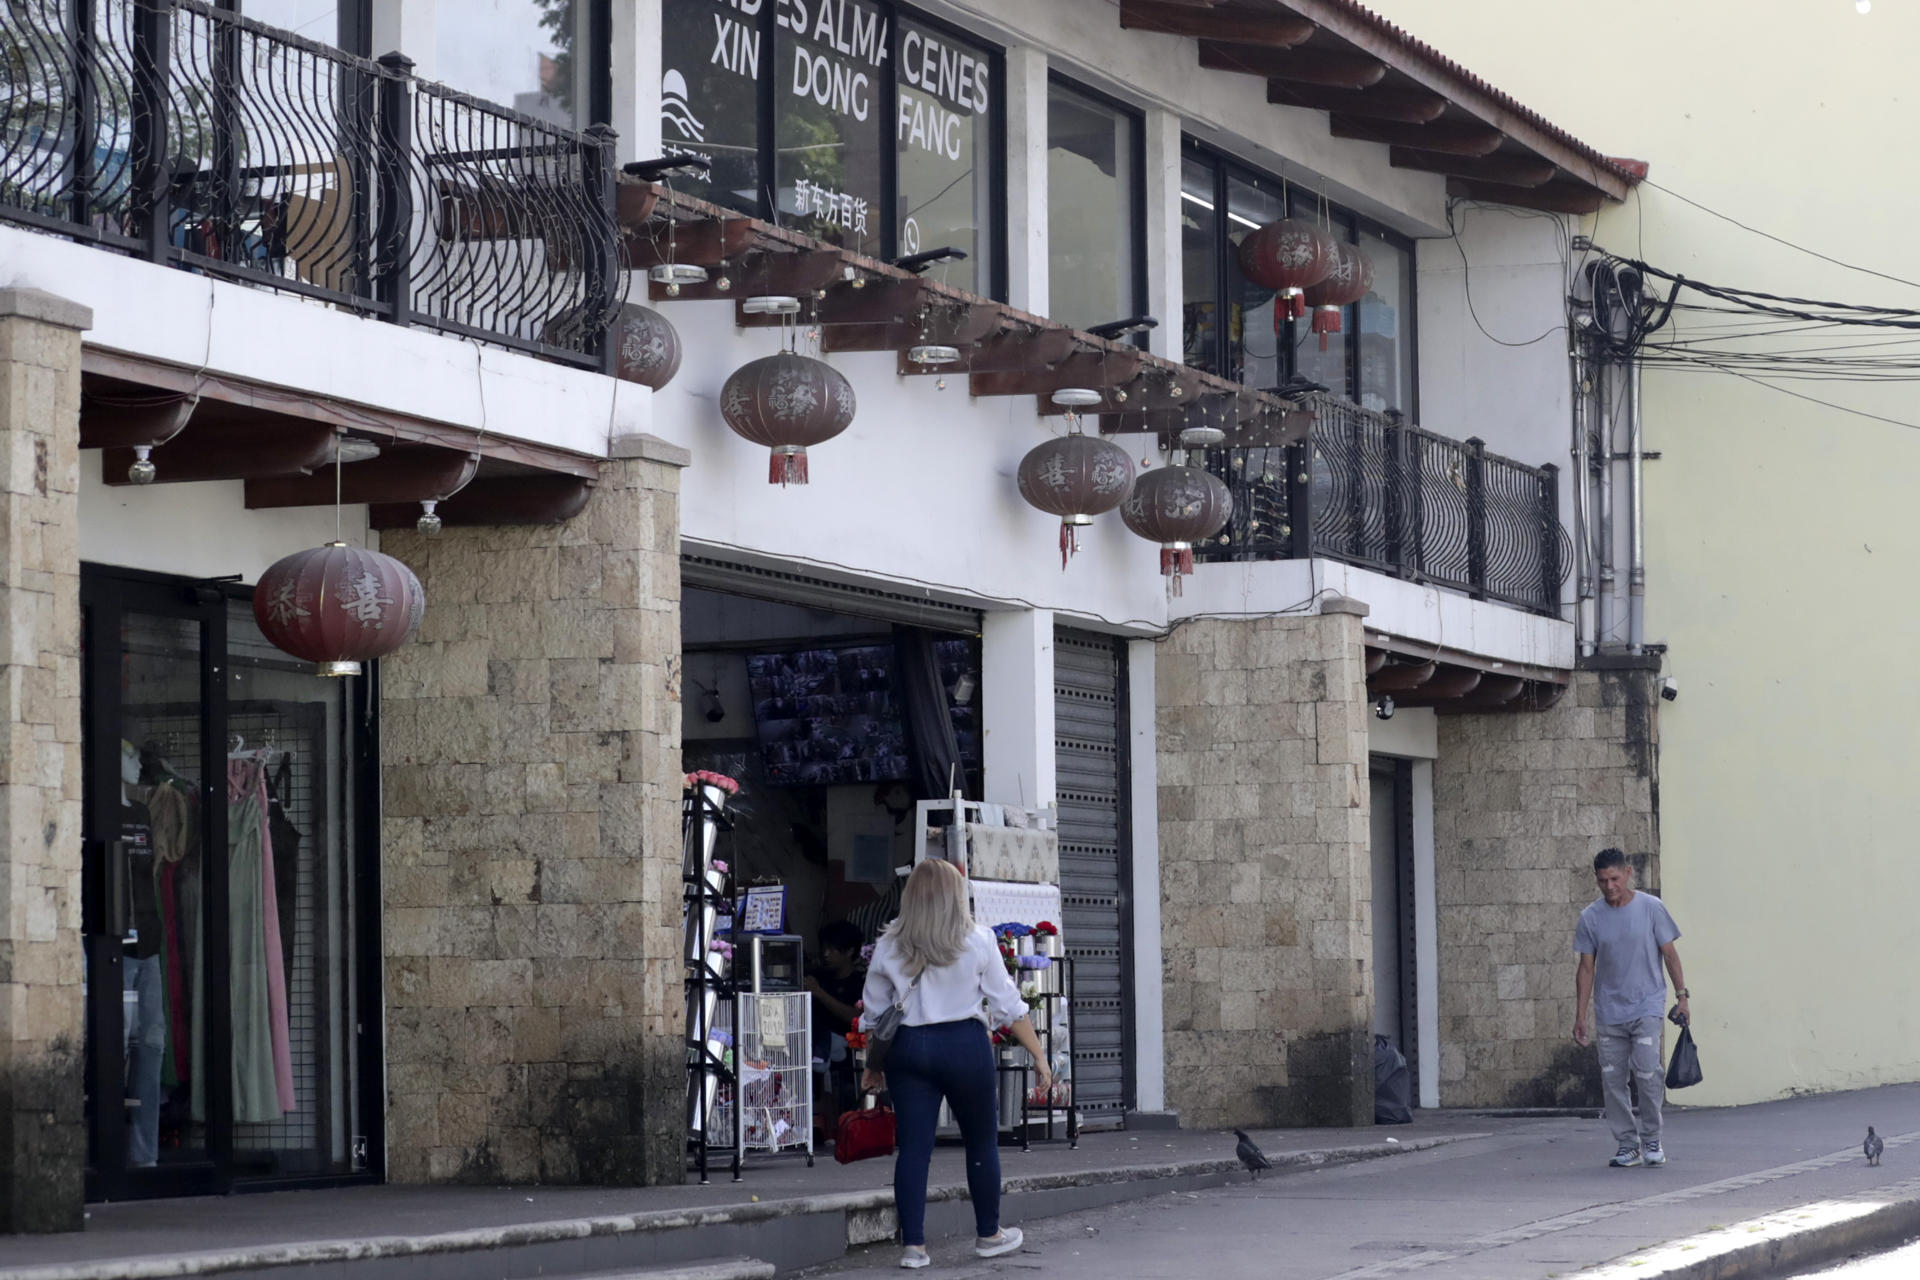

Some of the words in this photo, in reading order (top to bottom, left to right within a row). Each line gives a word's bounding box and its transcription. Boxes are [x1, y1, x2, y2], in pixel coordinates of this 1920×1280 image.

[710, 13, 761, 80] XIN
[793, 45, 869, 122] DONG
[898, 93, 961, 161] FANG
[795, 178, 869, 236] 新东方百货
